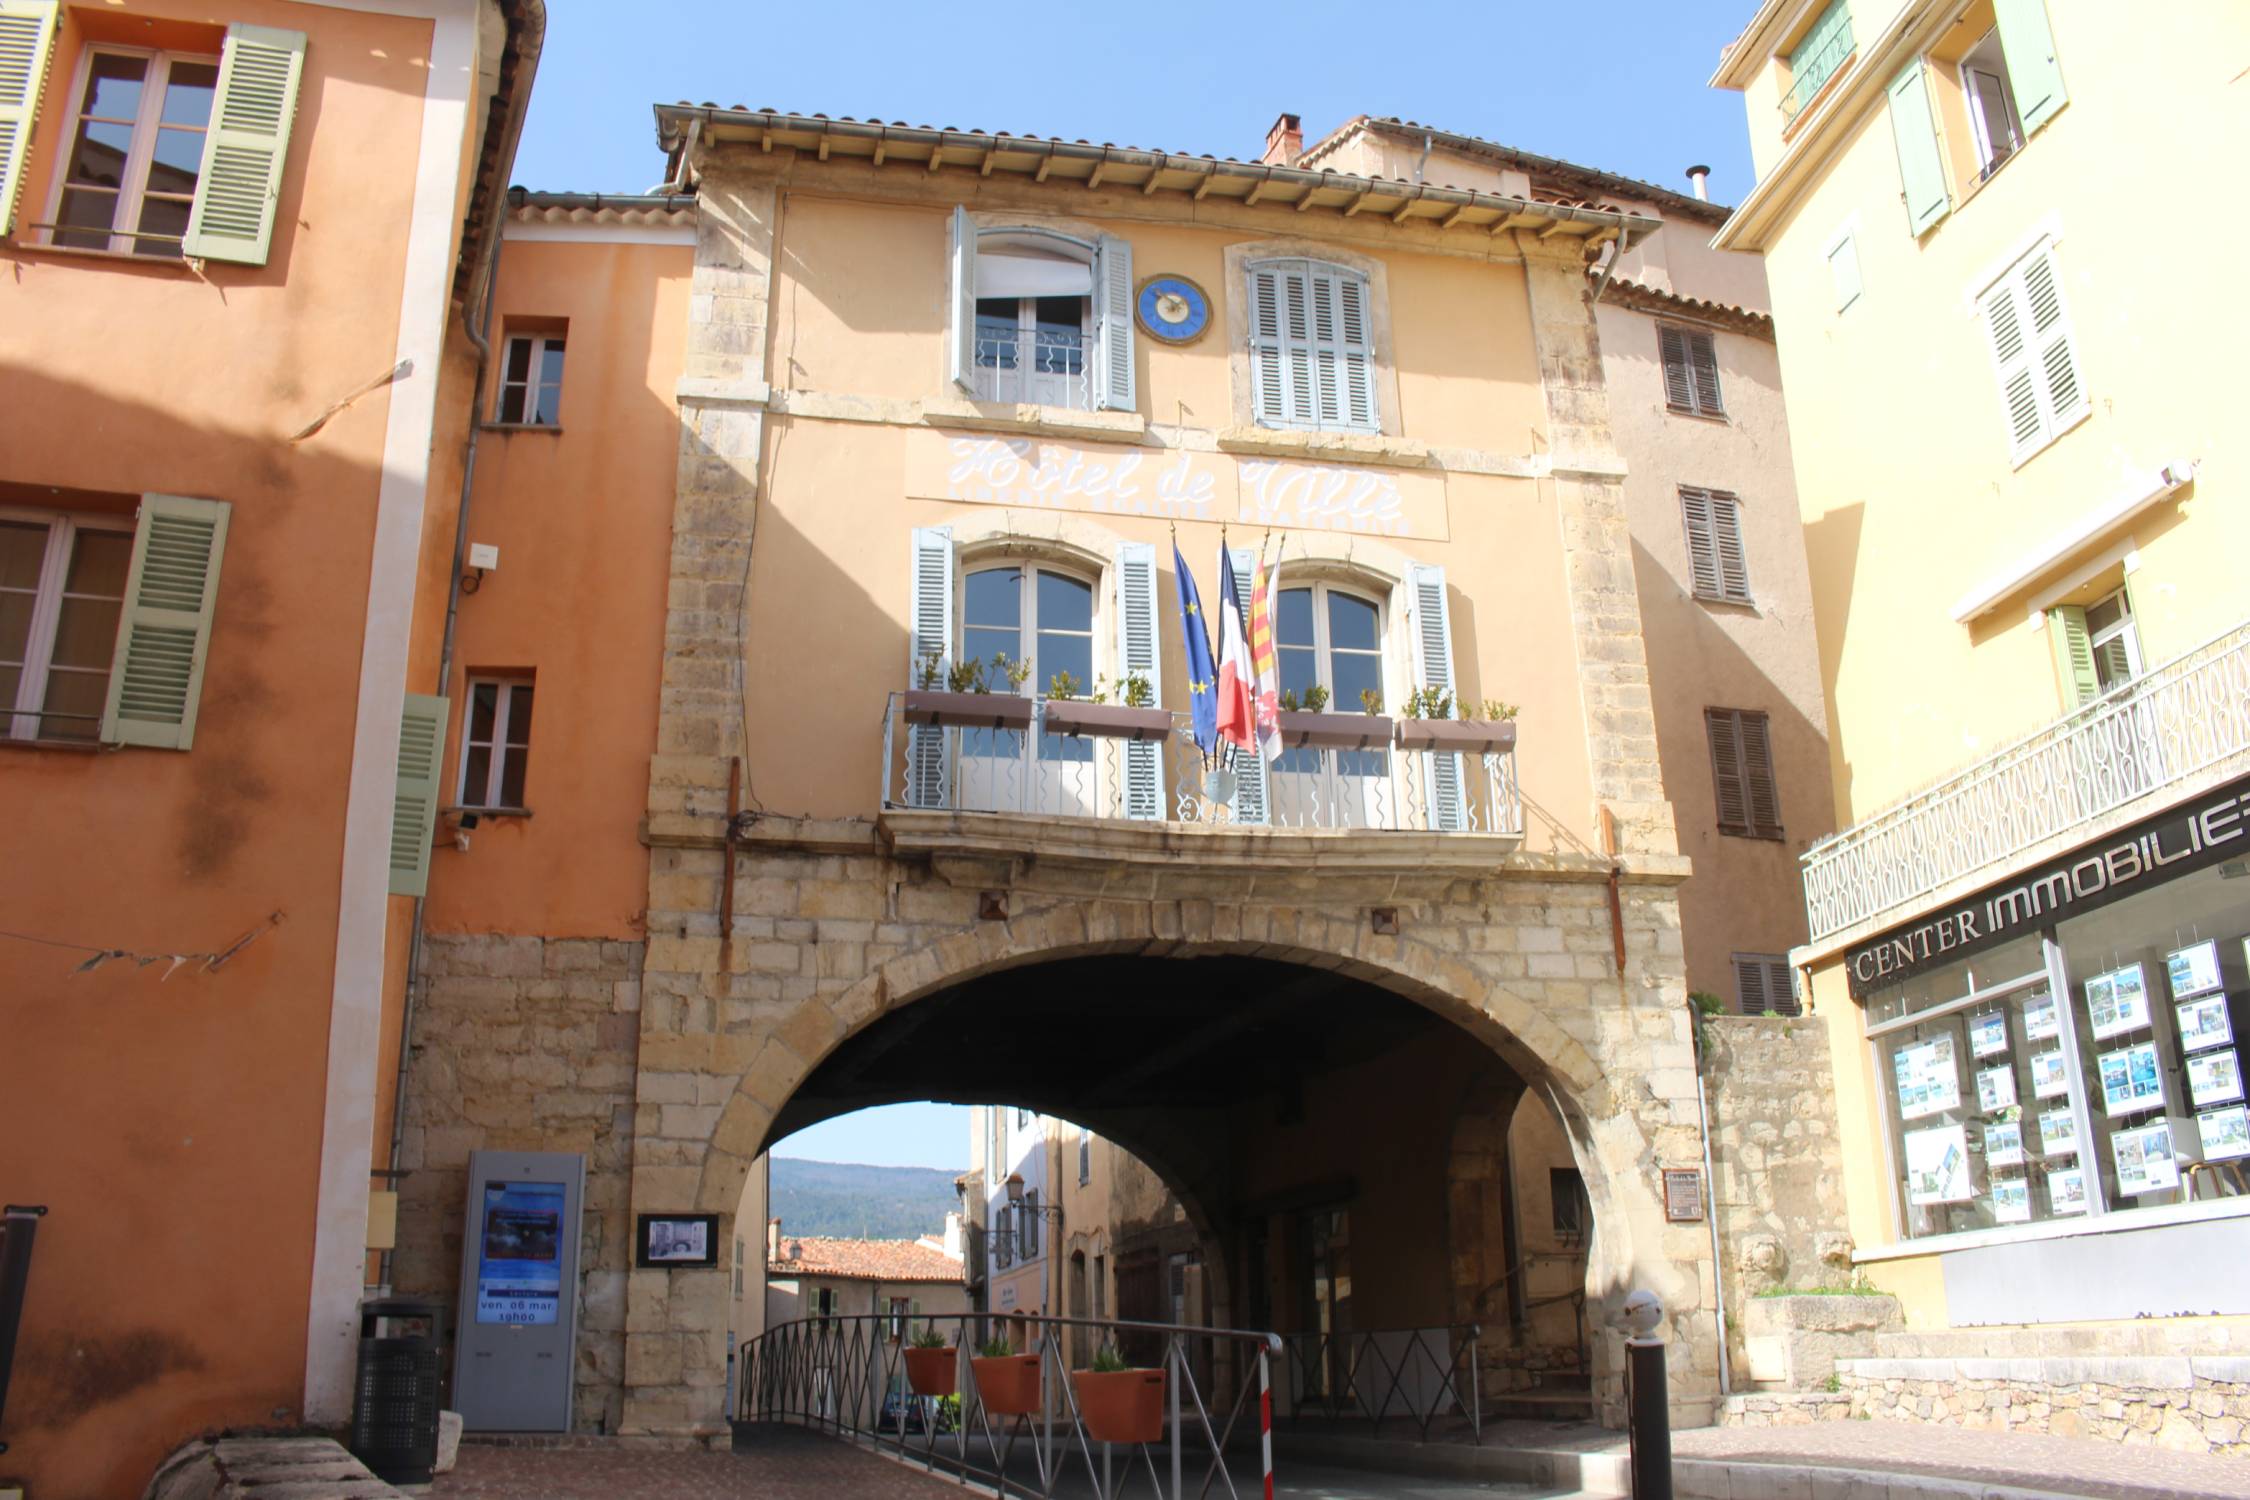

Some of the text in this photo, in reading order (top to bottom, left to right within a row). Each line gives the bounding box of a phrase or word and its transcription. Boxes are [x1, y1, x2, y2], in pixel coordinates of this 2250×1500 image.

[948, 434, 1404, 520] Hôtel de Ville
[1854, 909, 1982, 983] CENTER
[498, 1313, 536, 1322] 19h00
